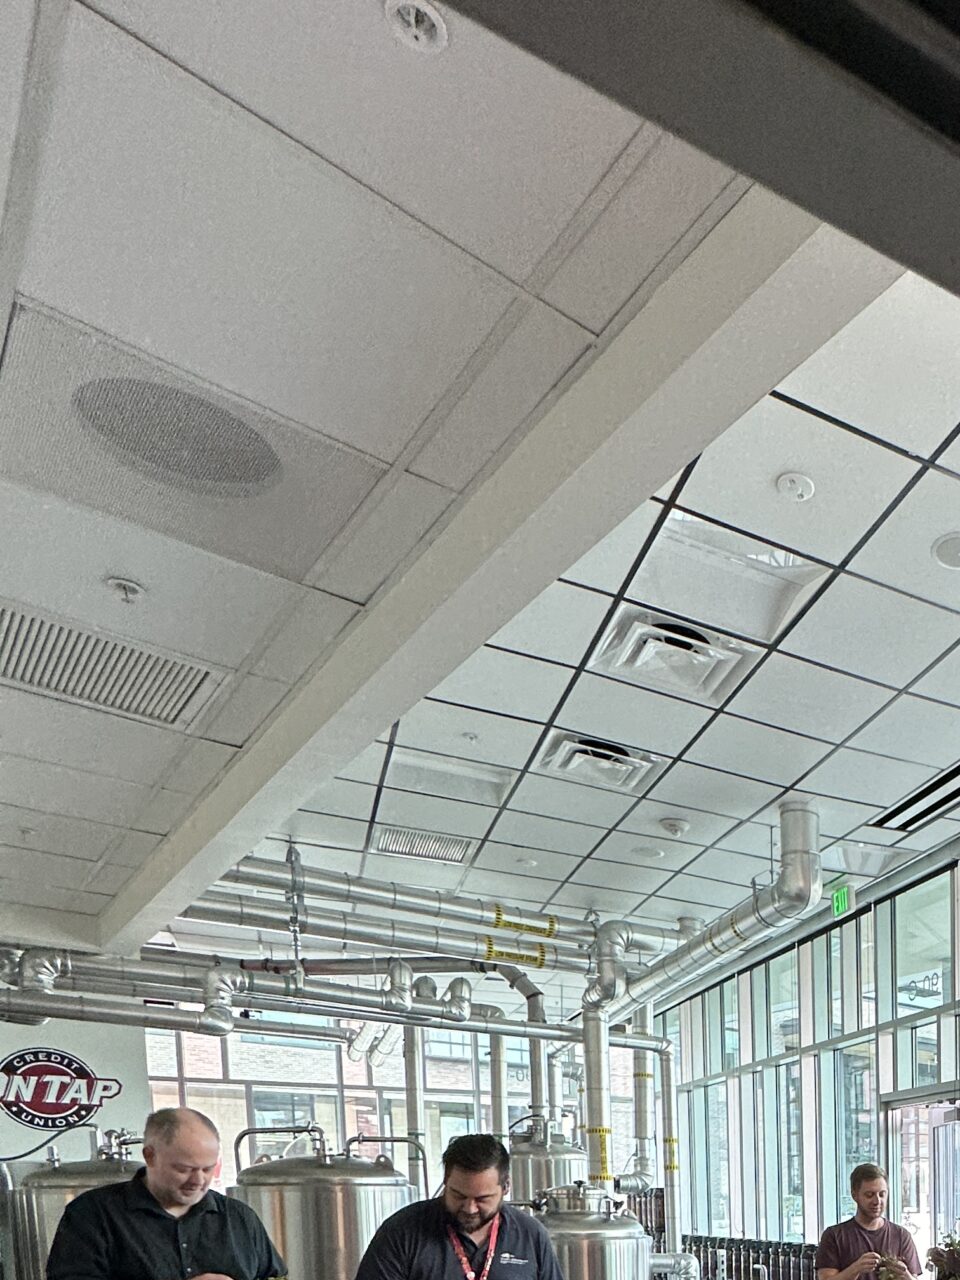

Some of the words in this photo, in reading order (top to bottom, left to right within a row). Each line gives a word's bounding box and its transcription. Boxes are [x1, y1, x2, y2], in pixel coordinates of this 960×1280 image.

[833, 887, 848, 917] EXIT
[13, 1053, 80, 1069] CREDIT
[42, 1074, 120, 1105] TAP
[21, 1112, 80, 1127] UNION
